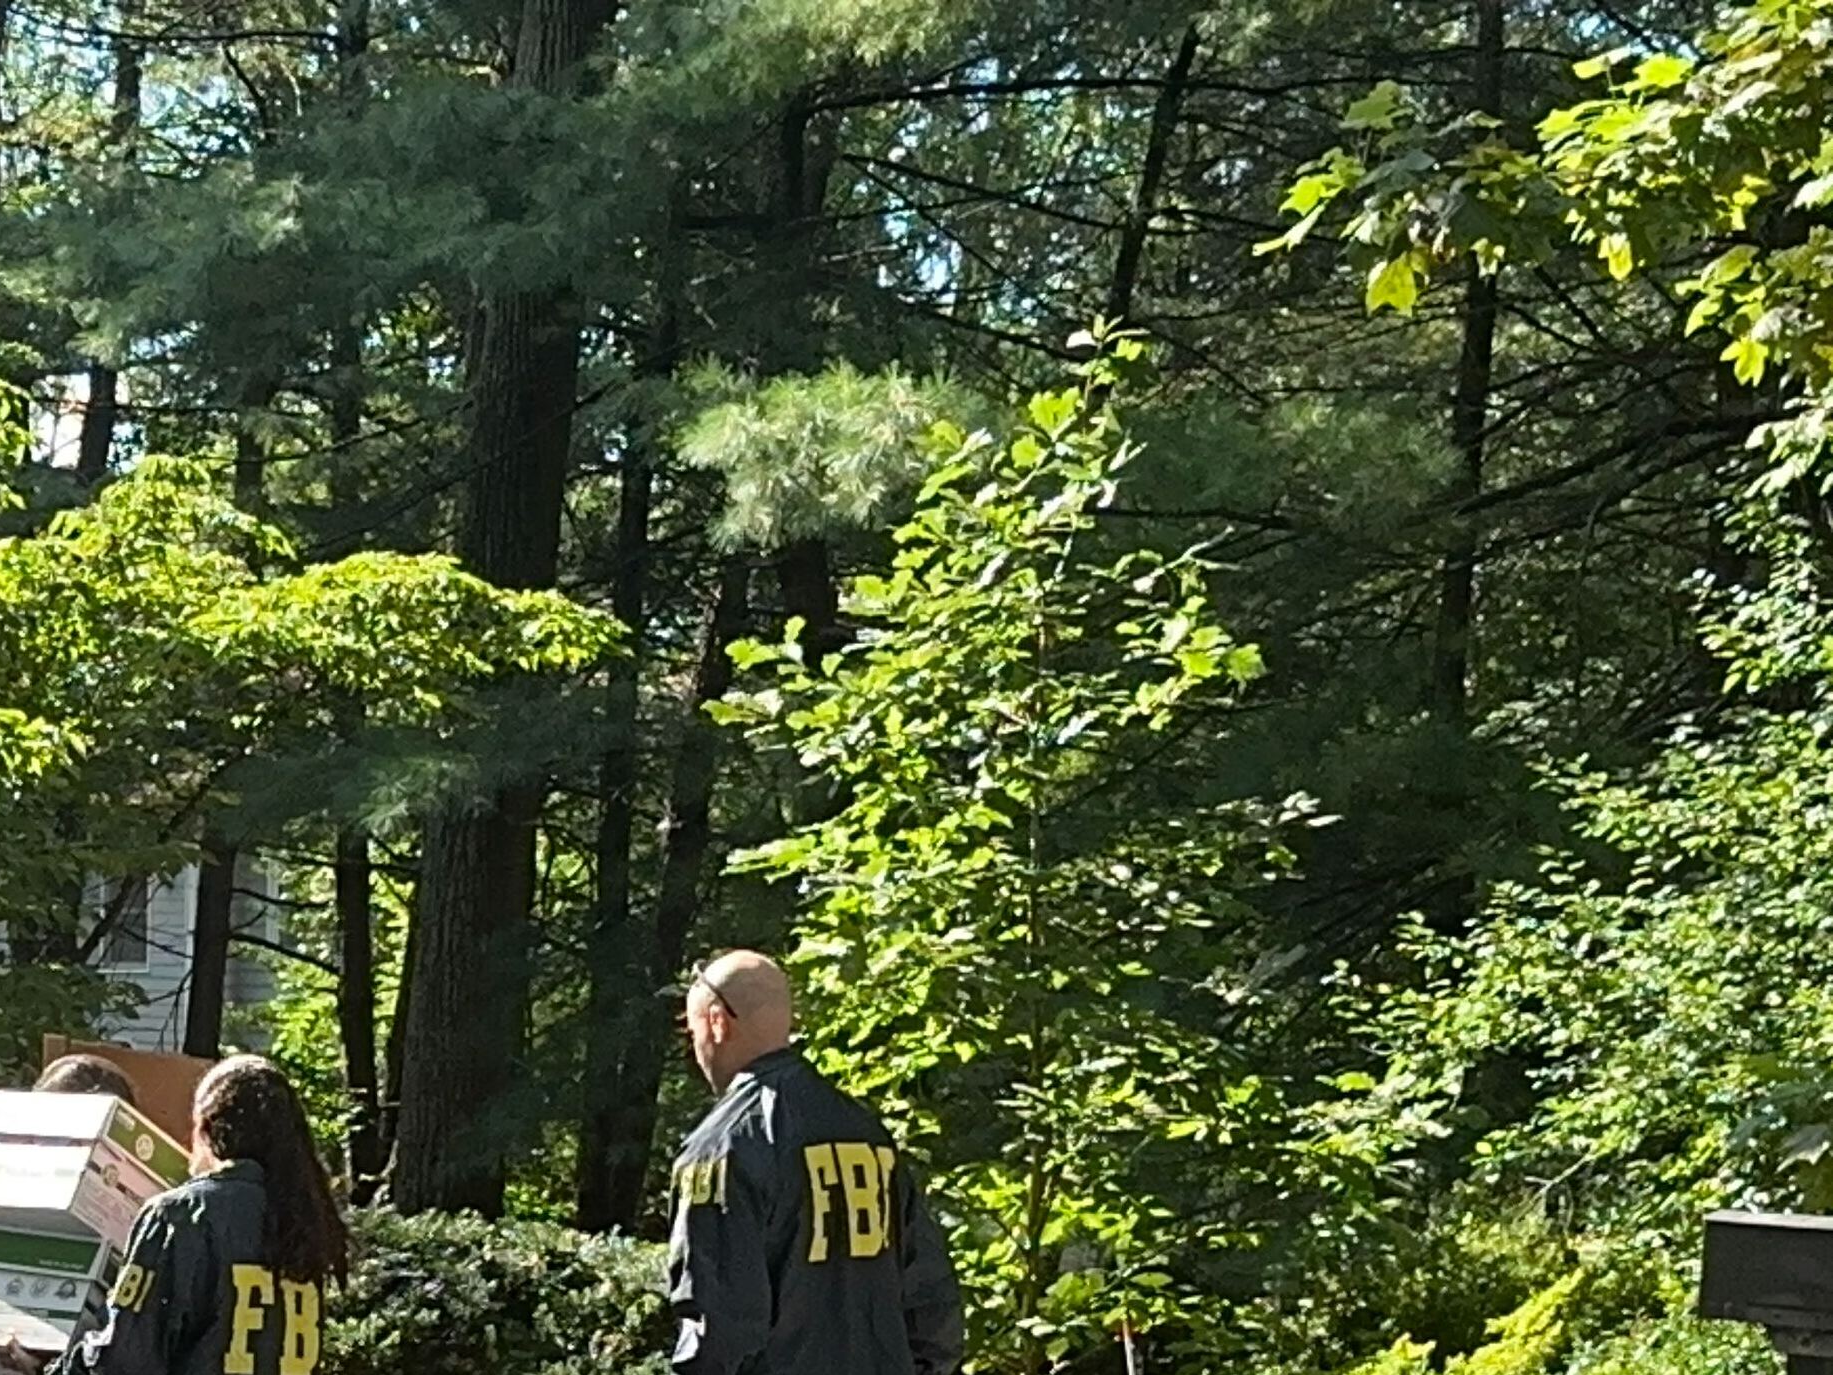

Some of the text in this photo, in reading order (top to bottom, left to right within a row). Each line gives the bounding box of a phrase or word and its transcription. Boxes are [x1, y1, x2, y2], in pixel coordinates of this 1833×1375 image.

[675, 1160, 727, 1205] BI
[803, 1142, 895, 1262] FBI
[112, 1264, 156, 1313] BI
